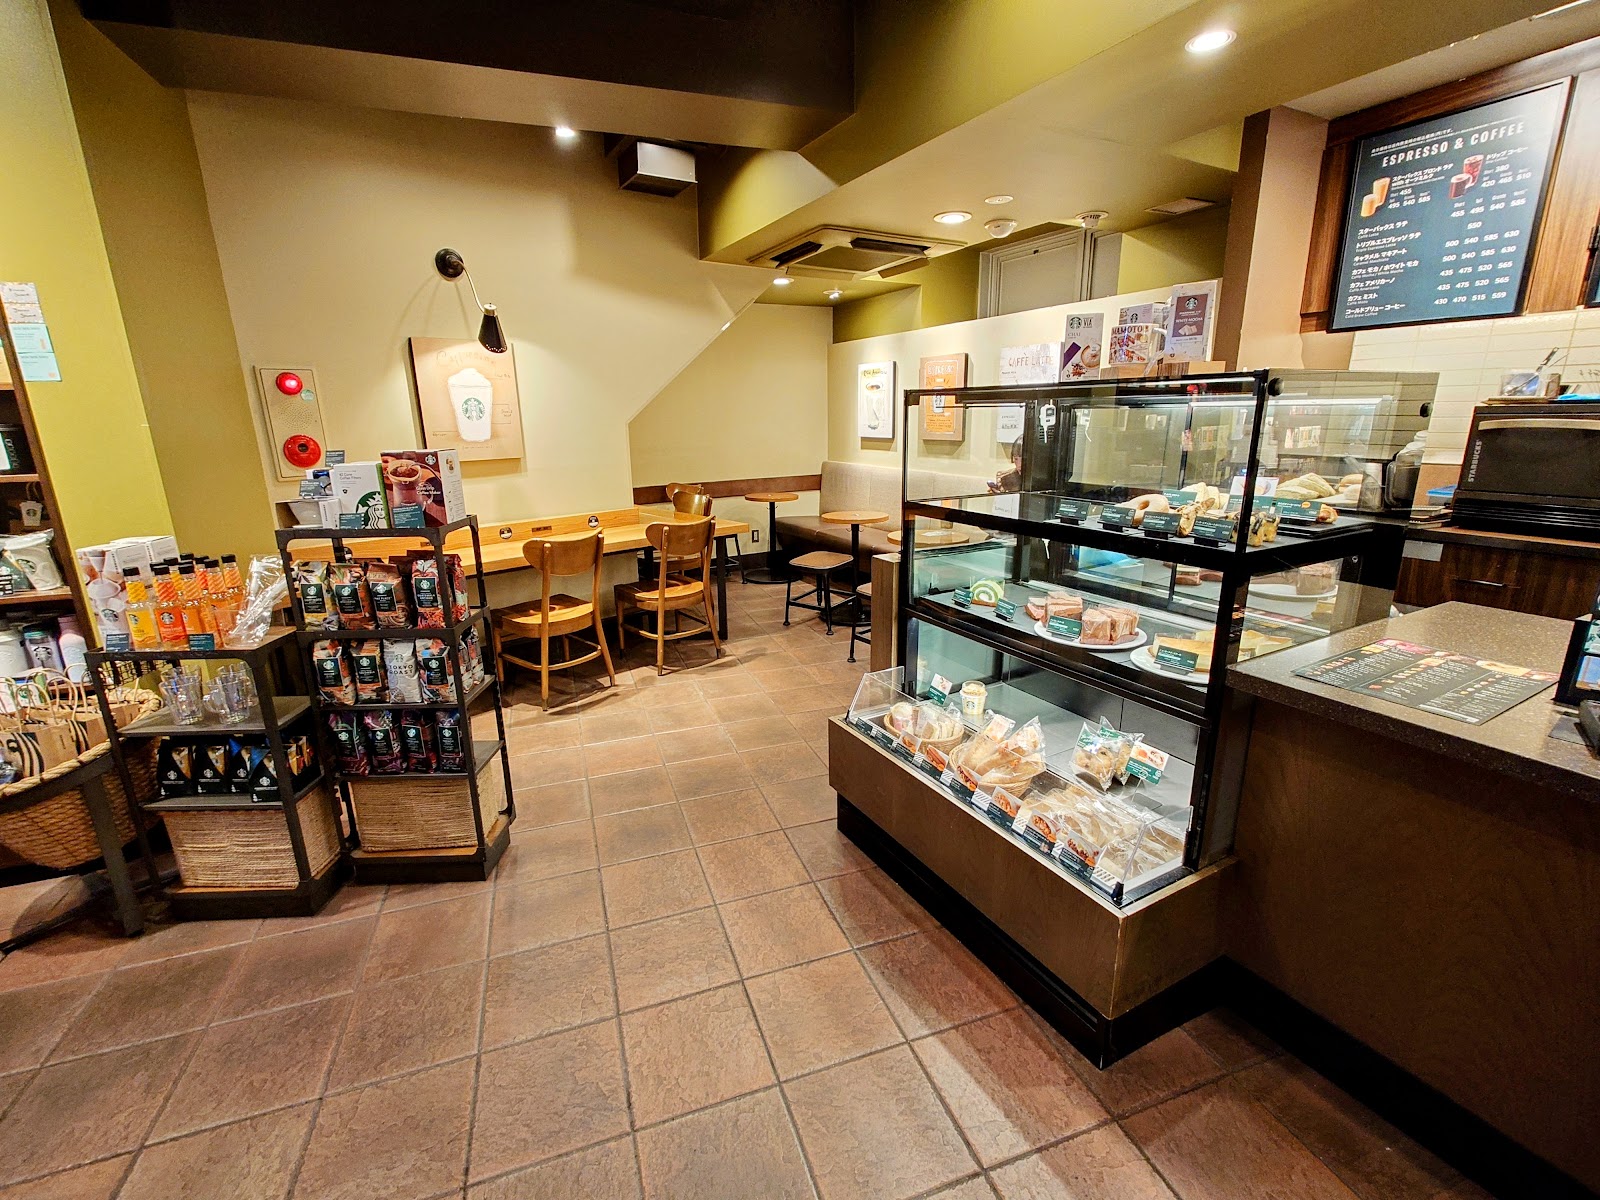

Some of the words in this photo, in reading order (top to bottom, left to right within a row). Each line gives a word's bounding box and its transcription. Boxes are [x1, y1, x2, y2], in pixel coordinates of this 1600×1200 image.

[1382, 141, 1449, 167] ESPRESSO
[1454, 137, 1464, 150] &
[1470, 122, 1524, 146] COFFEE
[1490, 202, 1505, 210] 540
[1358, 223, 1395, 235] スターバックス
[1396, 220, 1408, 228] ラテ
[1408, 231, 1421, 239] ラテ
[1463, 237, 1479, 245] 540
[1504, 230, 1520, 238] 630
[1354, 253, 1380, 262] キャラメル
[1381, 248, 1407, 258] マキアート
[1383, 262, 1405, 270] ホワイト
[1477, 264, 1492, 272] 520
[1497, 261, 1513, 269] 565
[1365, 277, 1396, 287] アメリカーノ
[1474, 279, 1489, 287] 520
[1494, 276, 1510, 284] 565
[1471, 293, 1486, 301] 515
[1345, 305, 1384, 315] コールドブリュー
[1384, 303, 1406, 311] コーヒー
